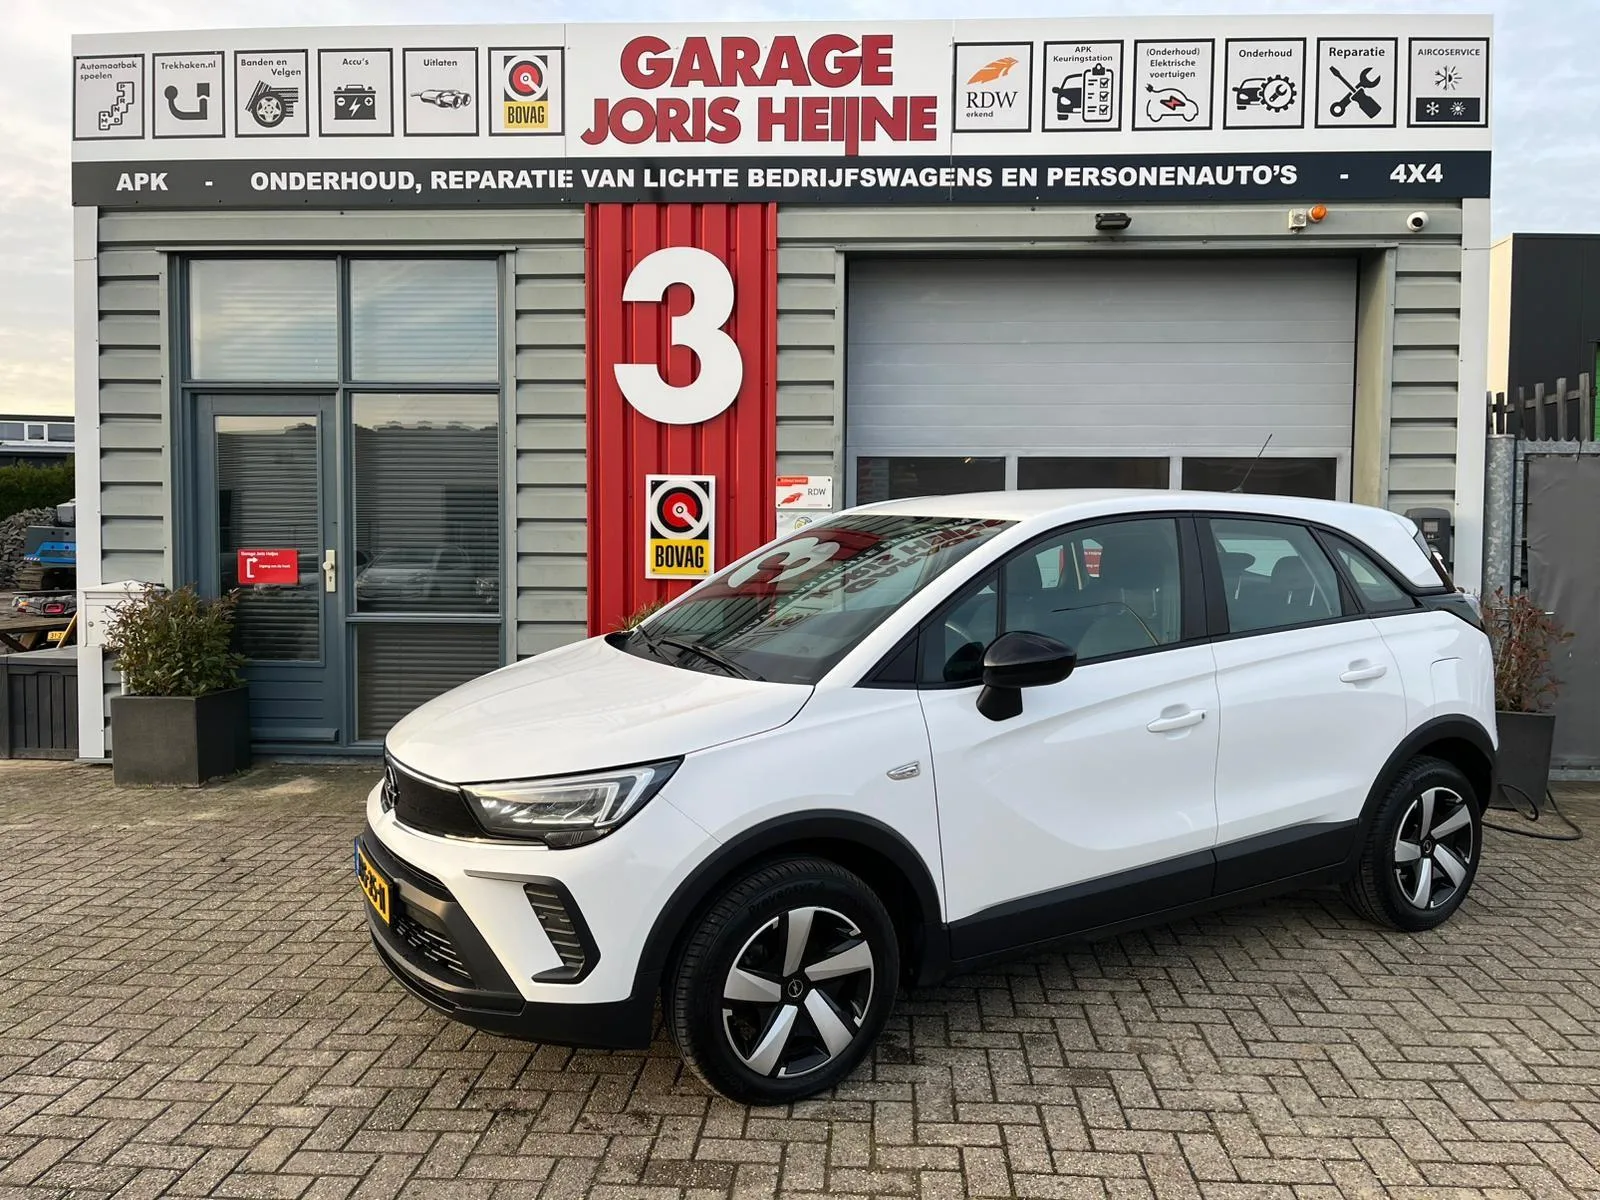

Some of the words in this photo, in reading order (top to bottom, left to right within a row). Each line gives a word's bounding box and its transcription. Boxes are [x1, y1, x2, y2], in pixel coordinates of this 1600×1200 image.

[1147, 48, 1200, 56] (Onderhoud)
[1239, 49, 1292, 57] Onderhoud
[1329, 47, 1385, 59] Reparatie
[241, 58, 273, 66] Banden
[620, 34, 893, 90] GARAGE
[1053, 55, 1112, 64] Keuringstation
[1150, 59, 1195, 67] Elektrische
[79, 60, 137, 70] Automaatbak
[161, 60, 215, 69] Trekhaken.nl
[80, 72, 112, 81] spoelen
[271, 68, 301, 77] Velgen
[1150, 70, 1195, 79] voertuigen
[967, 92, 1018, 108] RDW
[508, 106, 544, 124] BOVAG
[580, 96, 741, 145] JORIS
[758, 95, 937, 156] HEIJNE
[116, 173, 168, 191] APK
[251, 171, 421, 193] ONDERHOUD,
[431, 170, 573, 189] REPARATIE
[581, 169, 634, 187] VAN
[644, 169, 738, 187] LICHTE
[748, 168, 992, 187] BEDRIJFSWAGENS
[1002, 168, 1037, 186] EN
[1047, 165, 1297, 186] PERSONENAUTO'S
[1390, 164, 1443, 183] 4X4
[614, 246, 743, 425] 3
[656, 545, 704, 568] BOVAG
